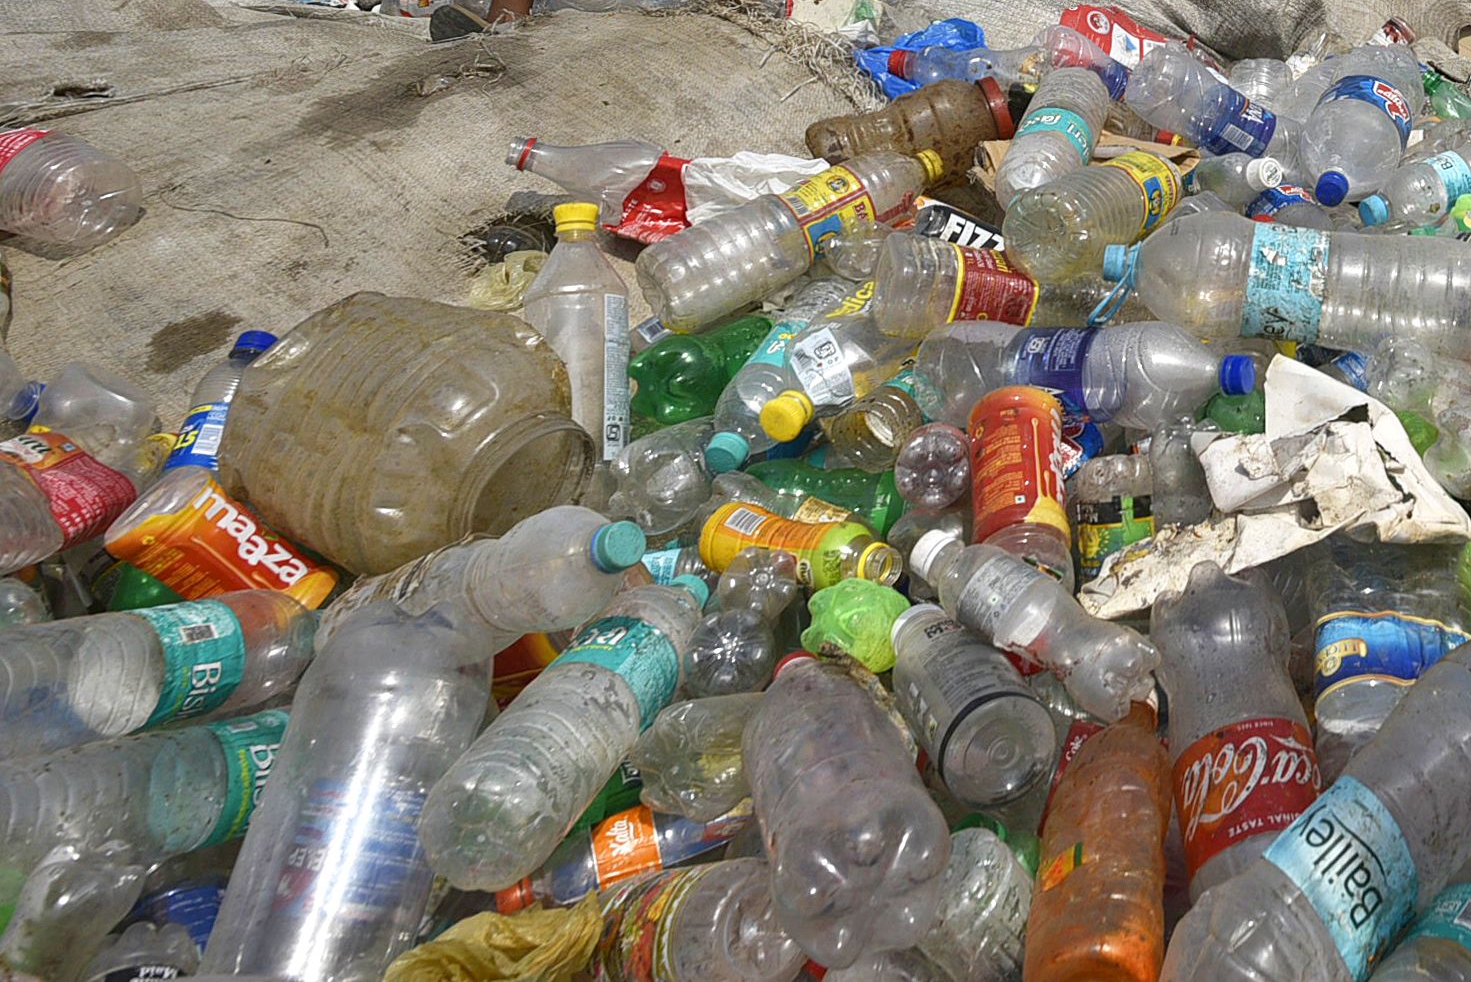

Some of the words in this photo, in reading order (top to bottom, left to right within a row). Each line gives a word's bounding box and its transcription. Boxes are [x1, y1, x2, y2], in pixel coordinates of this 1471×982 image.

[192, 486, 309, 587] maaza
[1228, 819, 1265, 839] TASTE
[1290, 804, 1384, 931] Bailley
